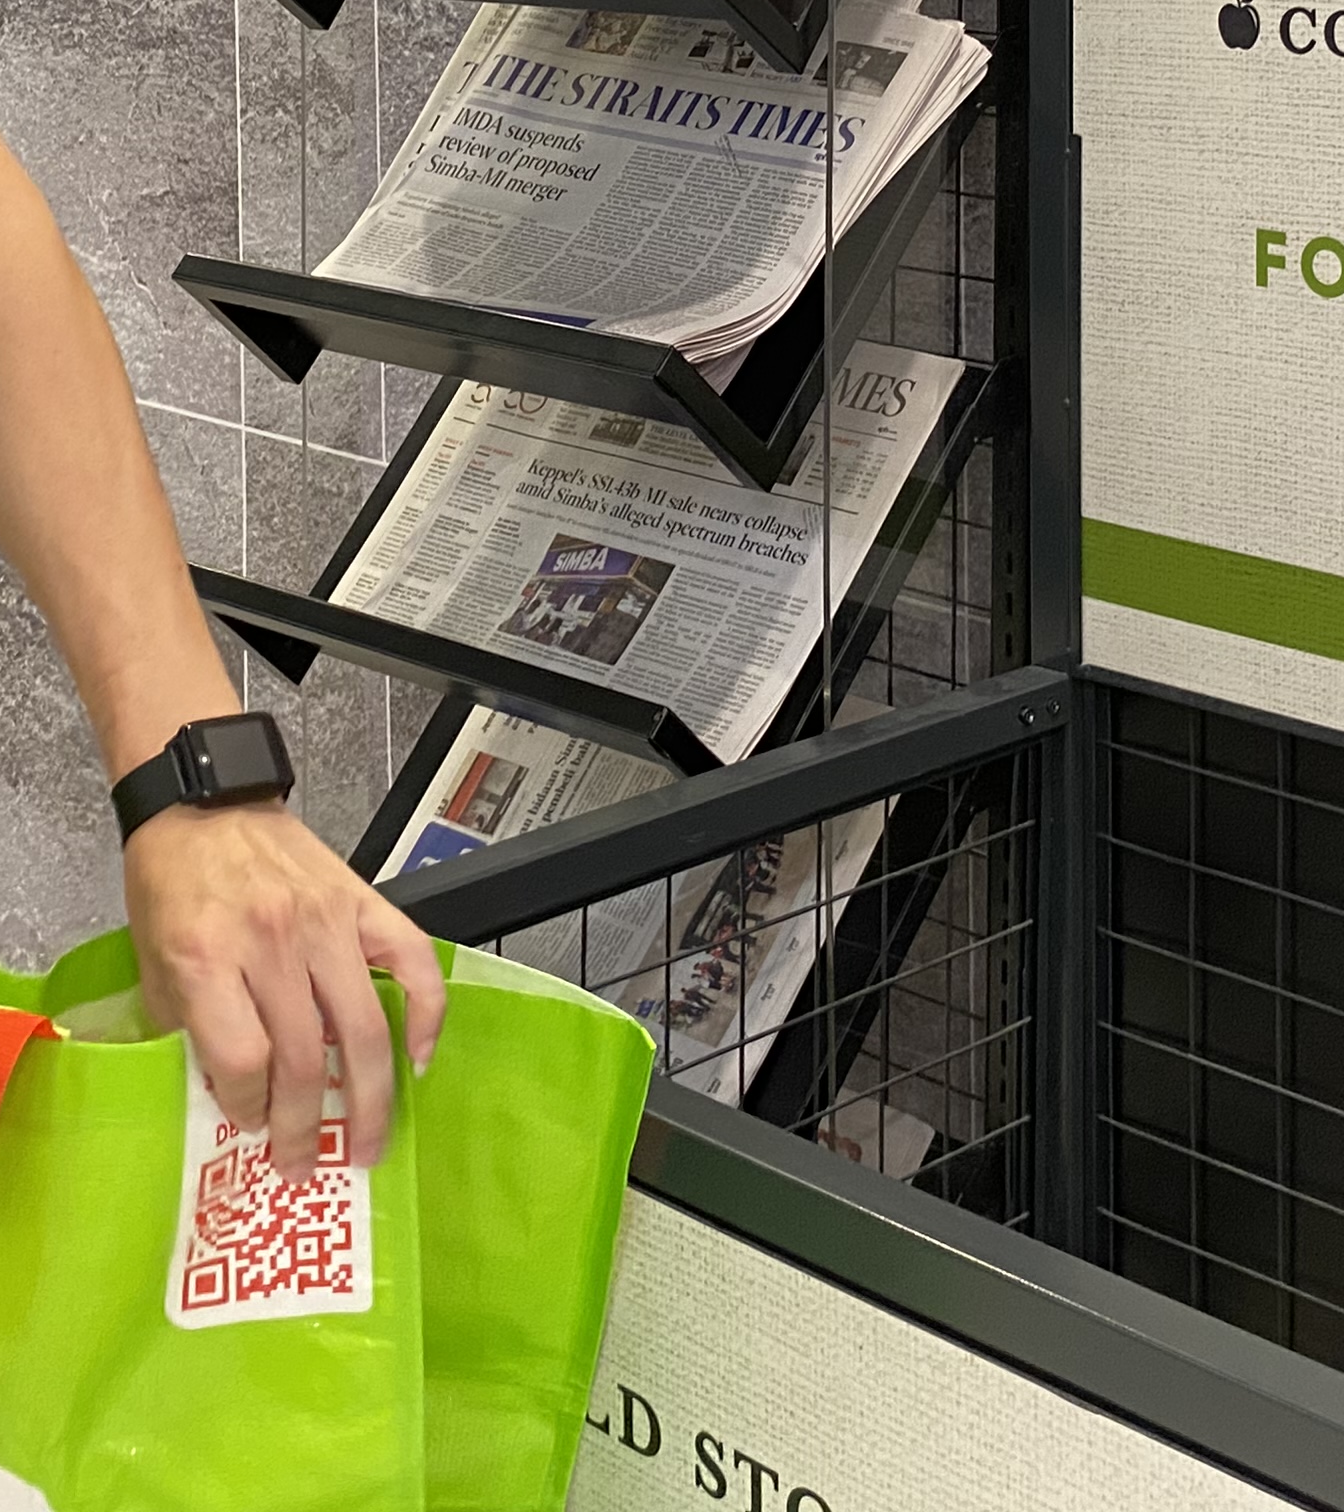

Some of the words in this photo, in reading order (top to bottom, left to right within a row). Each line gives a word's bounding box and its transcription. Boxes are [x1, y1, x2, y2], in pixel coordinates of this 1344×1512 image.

[482, 54, 569, 102] THE
[560, 72, 732, 130] STRAITS
[726, 98, 867, 153] TIMES
[452, 107, 504, 135] IMDA
[504, 122, 585, 153] suspends
[438, 135, 496, 160] review
[497, 147, 522, 165] of
[512, 155, 602, 182] proposed
[504, 177, 569, 203] merger
[515, 479, 555, 501] amid
[552, 488, 608, 515] Simba's
[609, 501, 666, 529] alleged
[662, 516, 736, 548] spectrum
[736, 532, 810, 566] breaches
[527, 458, 587, 486] Keppel's
[666, 495, 698, 514] sale
[698, 504, 743, 525] nears
[743, 514, 809, 541] collapse
[552, 547, 610, 573] SIMBA
